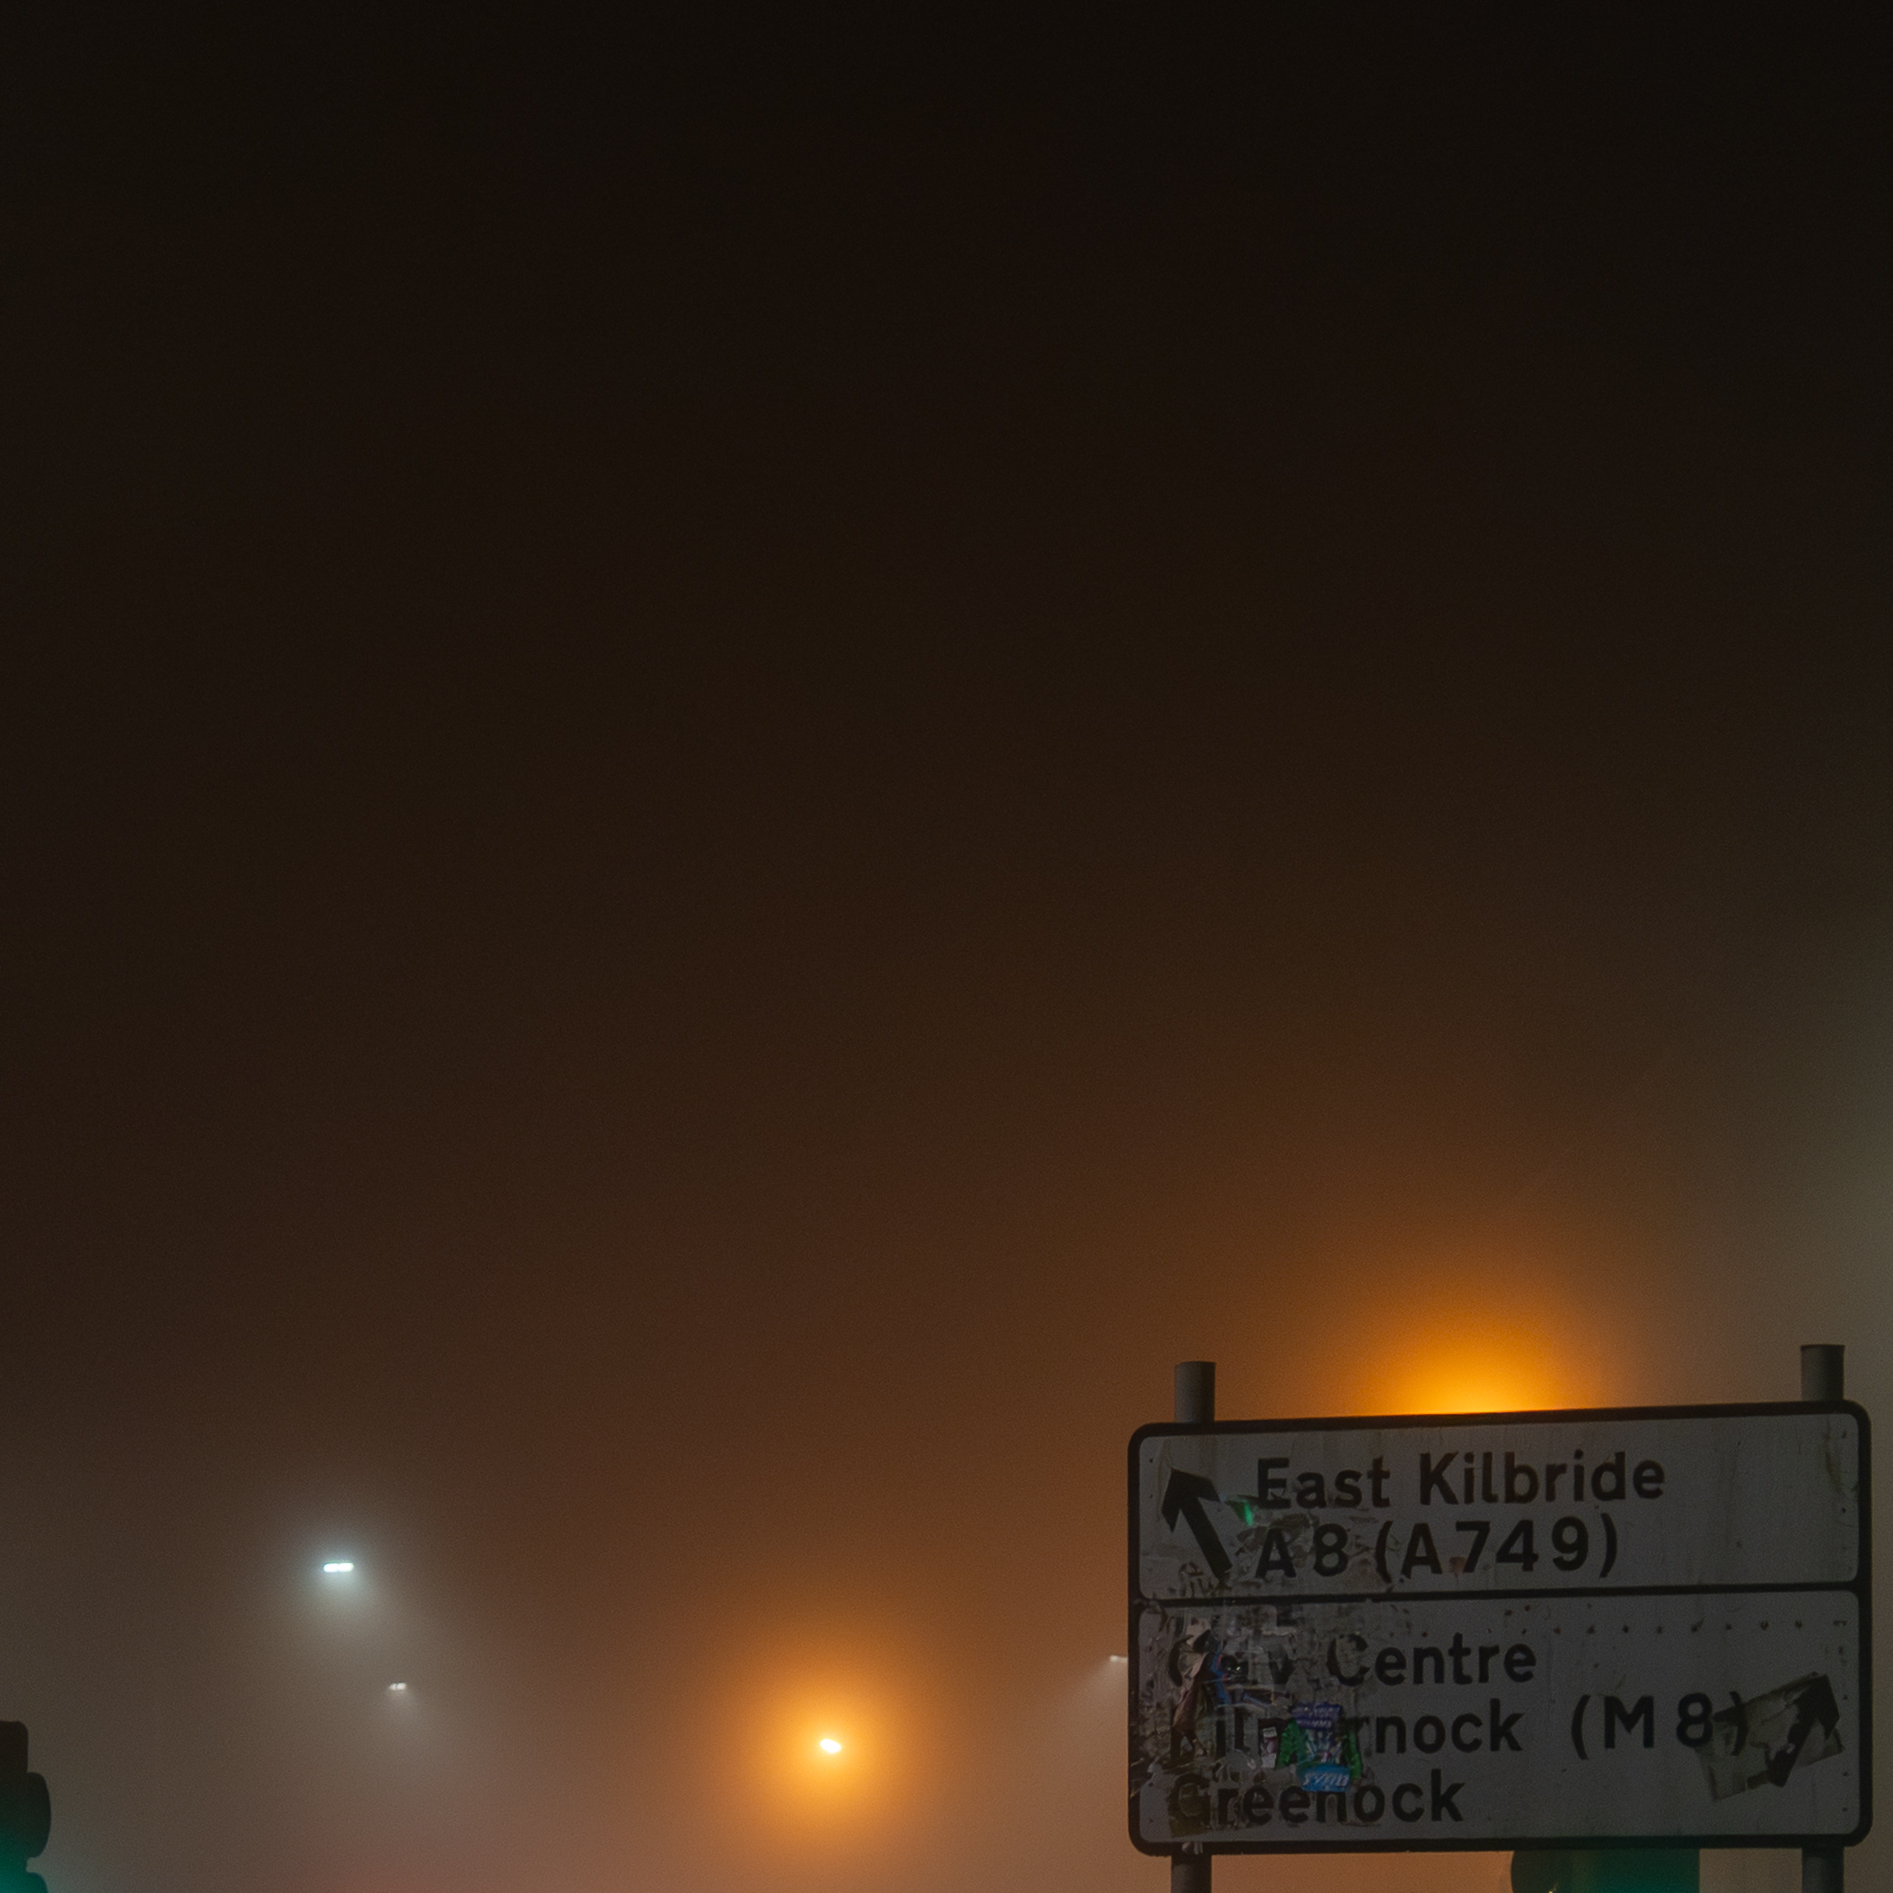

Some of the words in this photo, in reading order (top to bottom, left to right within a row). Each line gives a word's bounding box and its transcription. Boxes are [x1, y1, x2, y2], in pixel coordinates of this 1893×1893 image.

[1257, 1455, 1391, 1510] East
[1419, 1448, 1666, 1506] Kilbride
[1375, 1511, 1619, 1584] (A749)
[1325, 1631, 1538, 1688] Centre
[1168, 1766, 1466, 1826] Greenock
